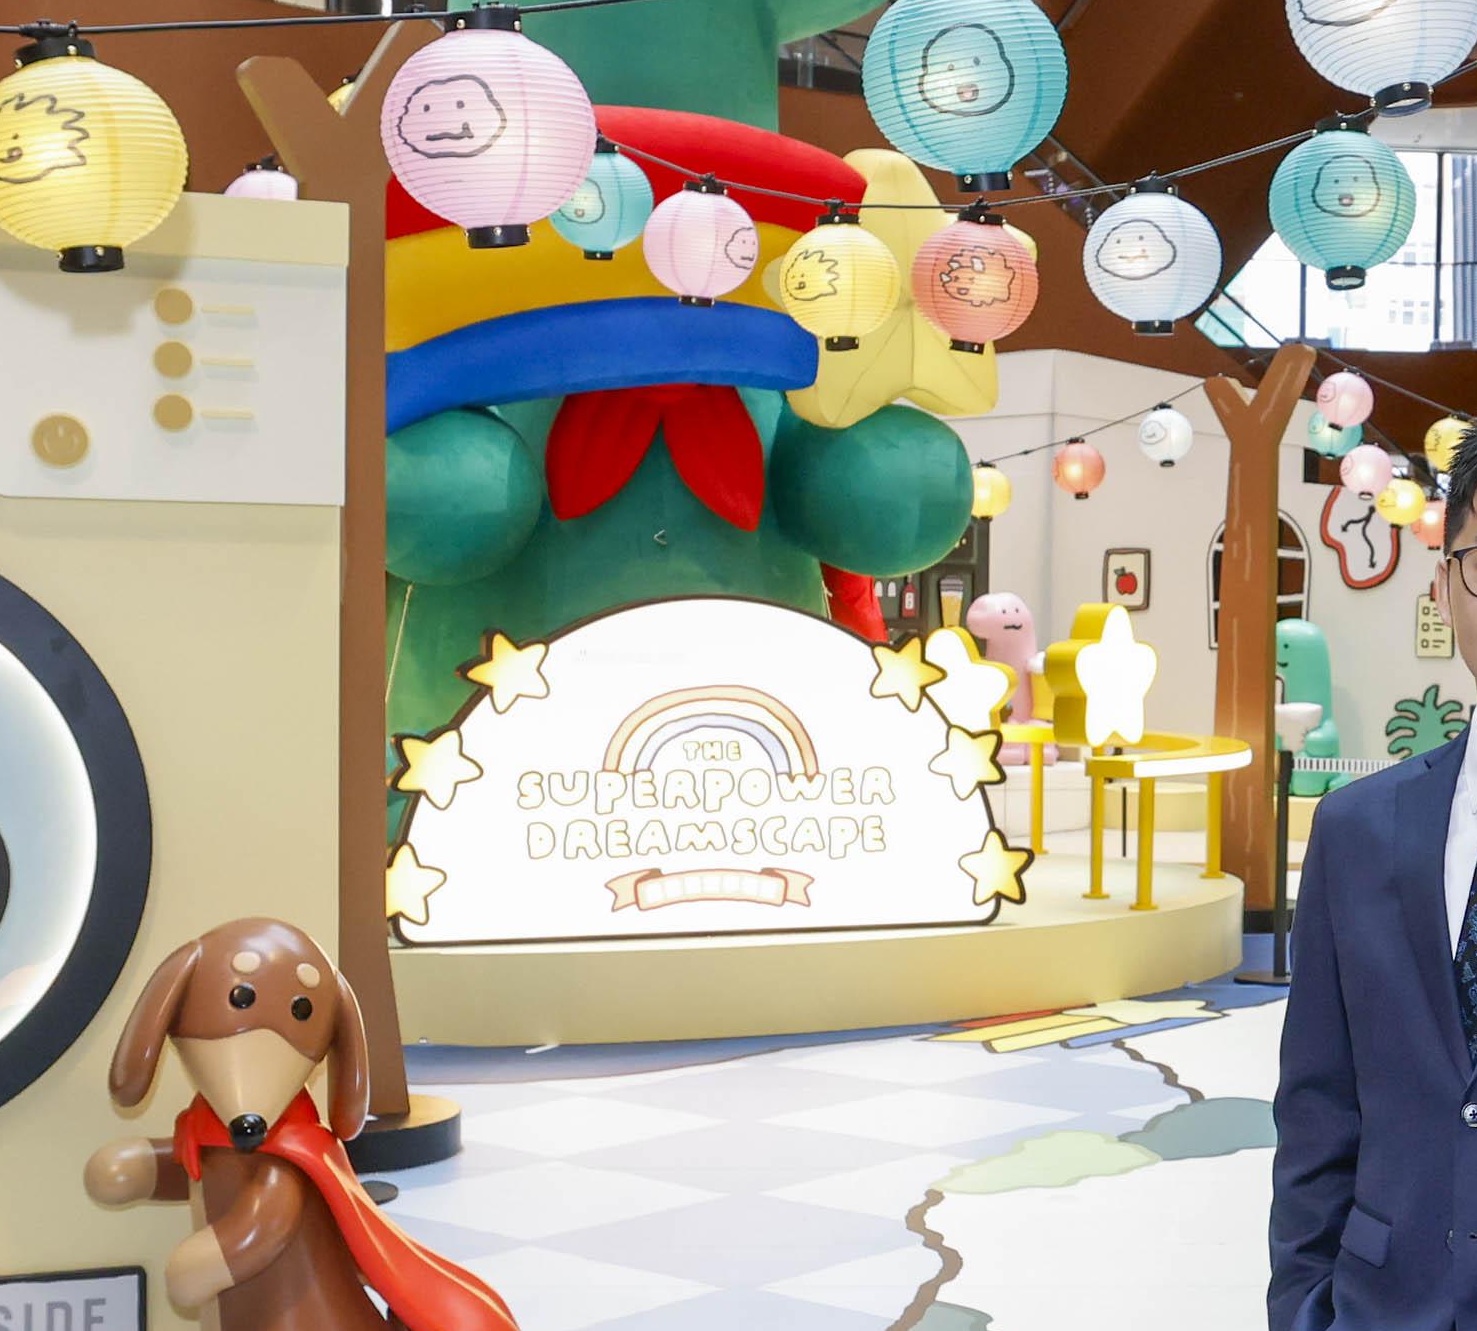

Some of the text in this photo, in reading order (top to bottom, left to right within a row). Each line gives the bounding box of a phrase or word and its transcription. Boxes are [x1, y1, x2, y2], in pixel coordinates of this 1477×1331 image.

[683, 741, 742, 761] THE
[517, 766, 896, 814] SUPERPOWER
[527, 815, 887, 860] DREAMSCAPE
